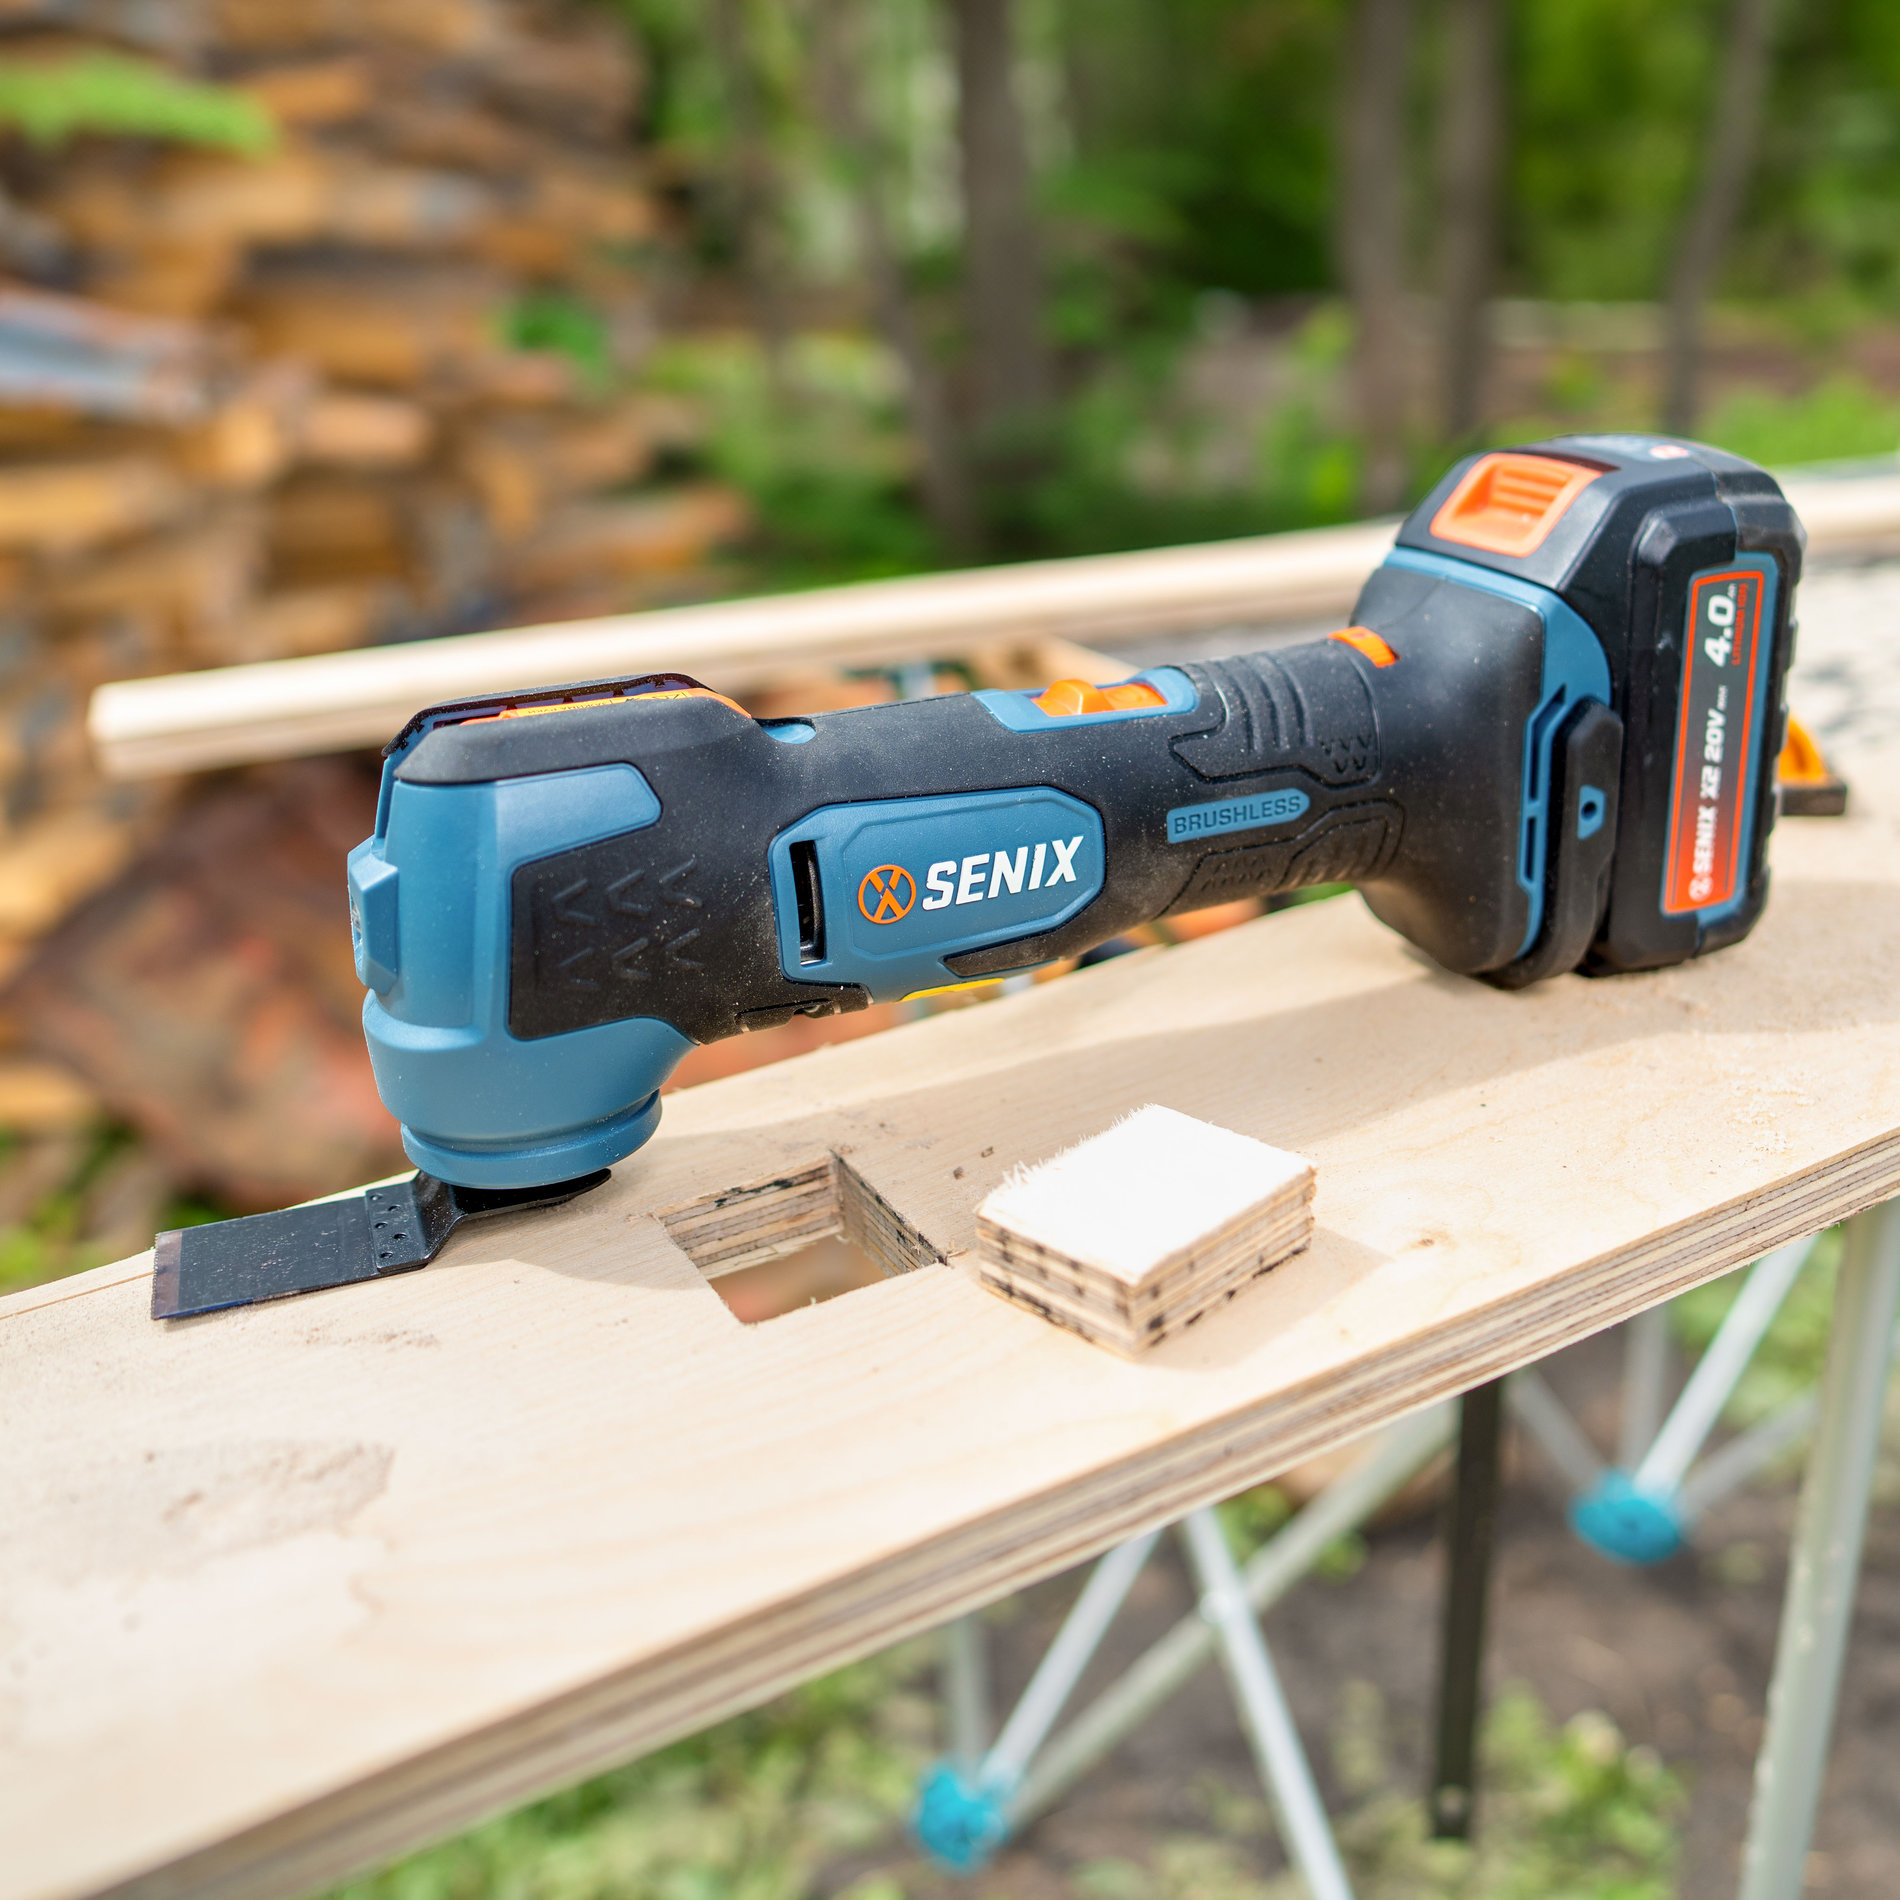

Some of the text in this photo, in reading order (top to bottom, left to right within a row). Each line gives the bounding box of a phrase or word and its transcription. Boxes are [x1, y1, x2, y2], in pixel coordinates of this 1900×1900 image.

[1704, 594, 1736, 667] 4.0
[1703, 707, 1726, 763] 20V
[1173, 795, 1301, 835] BRUSHLESS
[1692, 805, 1718, 874] SENIX
[921, 835, 1084, 911] SENIX
